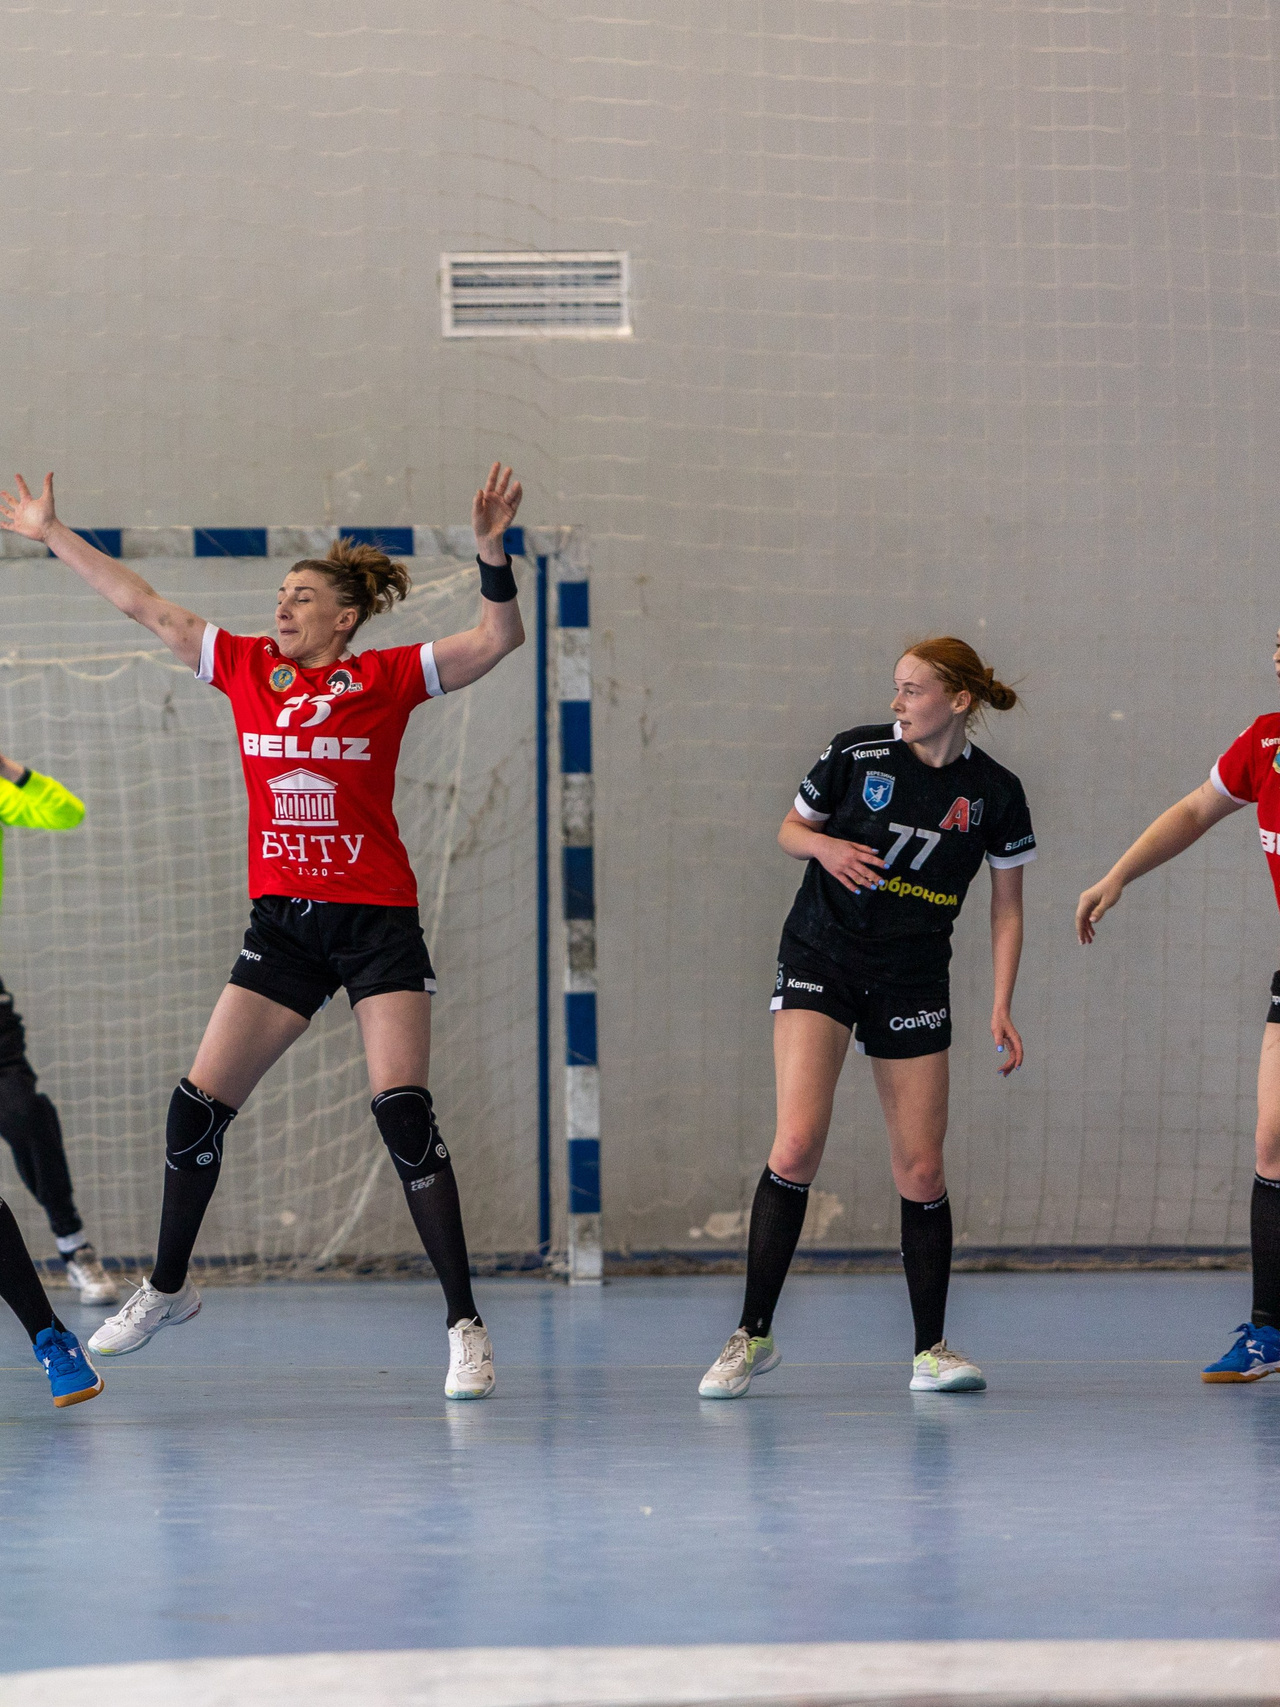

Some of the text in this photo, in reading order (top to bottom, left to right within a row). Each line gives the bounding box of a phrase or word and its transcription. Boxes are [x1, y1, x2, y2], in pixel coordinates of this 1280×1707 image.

[242, 732, 371, 761] BELAZ
[852, 747, 890, 761] Kempa
[939, 796, 984, 832] A1
[261, 830, 364, 864] БНТУ
[883, 822, 941, 871] 77
[1005, 834, 1036, 851] БЕЛТЕ
[878, 875, 958, 906] оброном
[787, 978, 824, 993] Kempa
